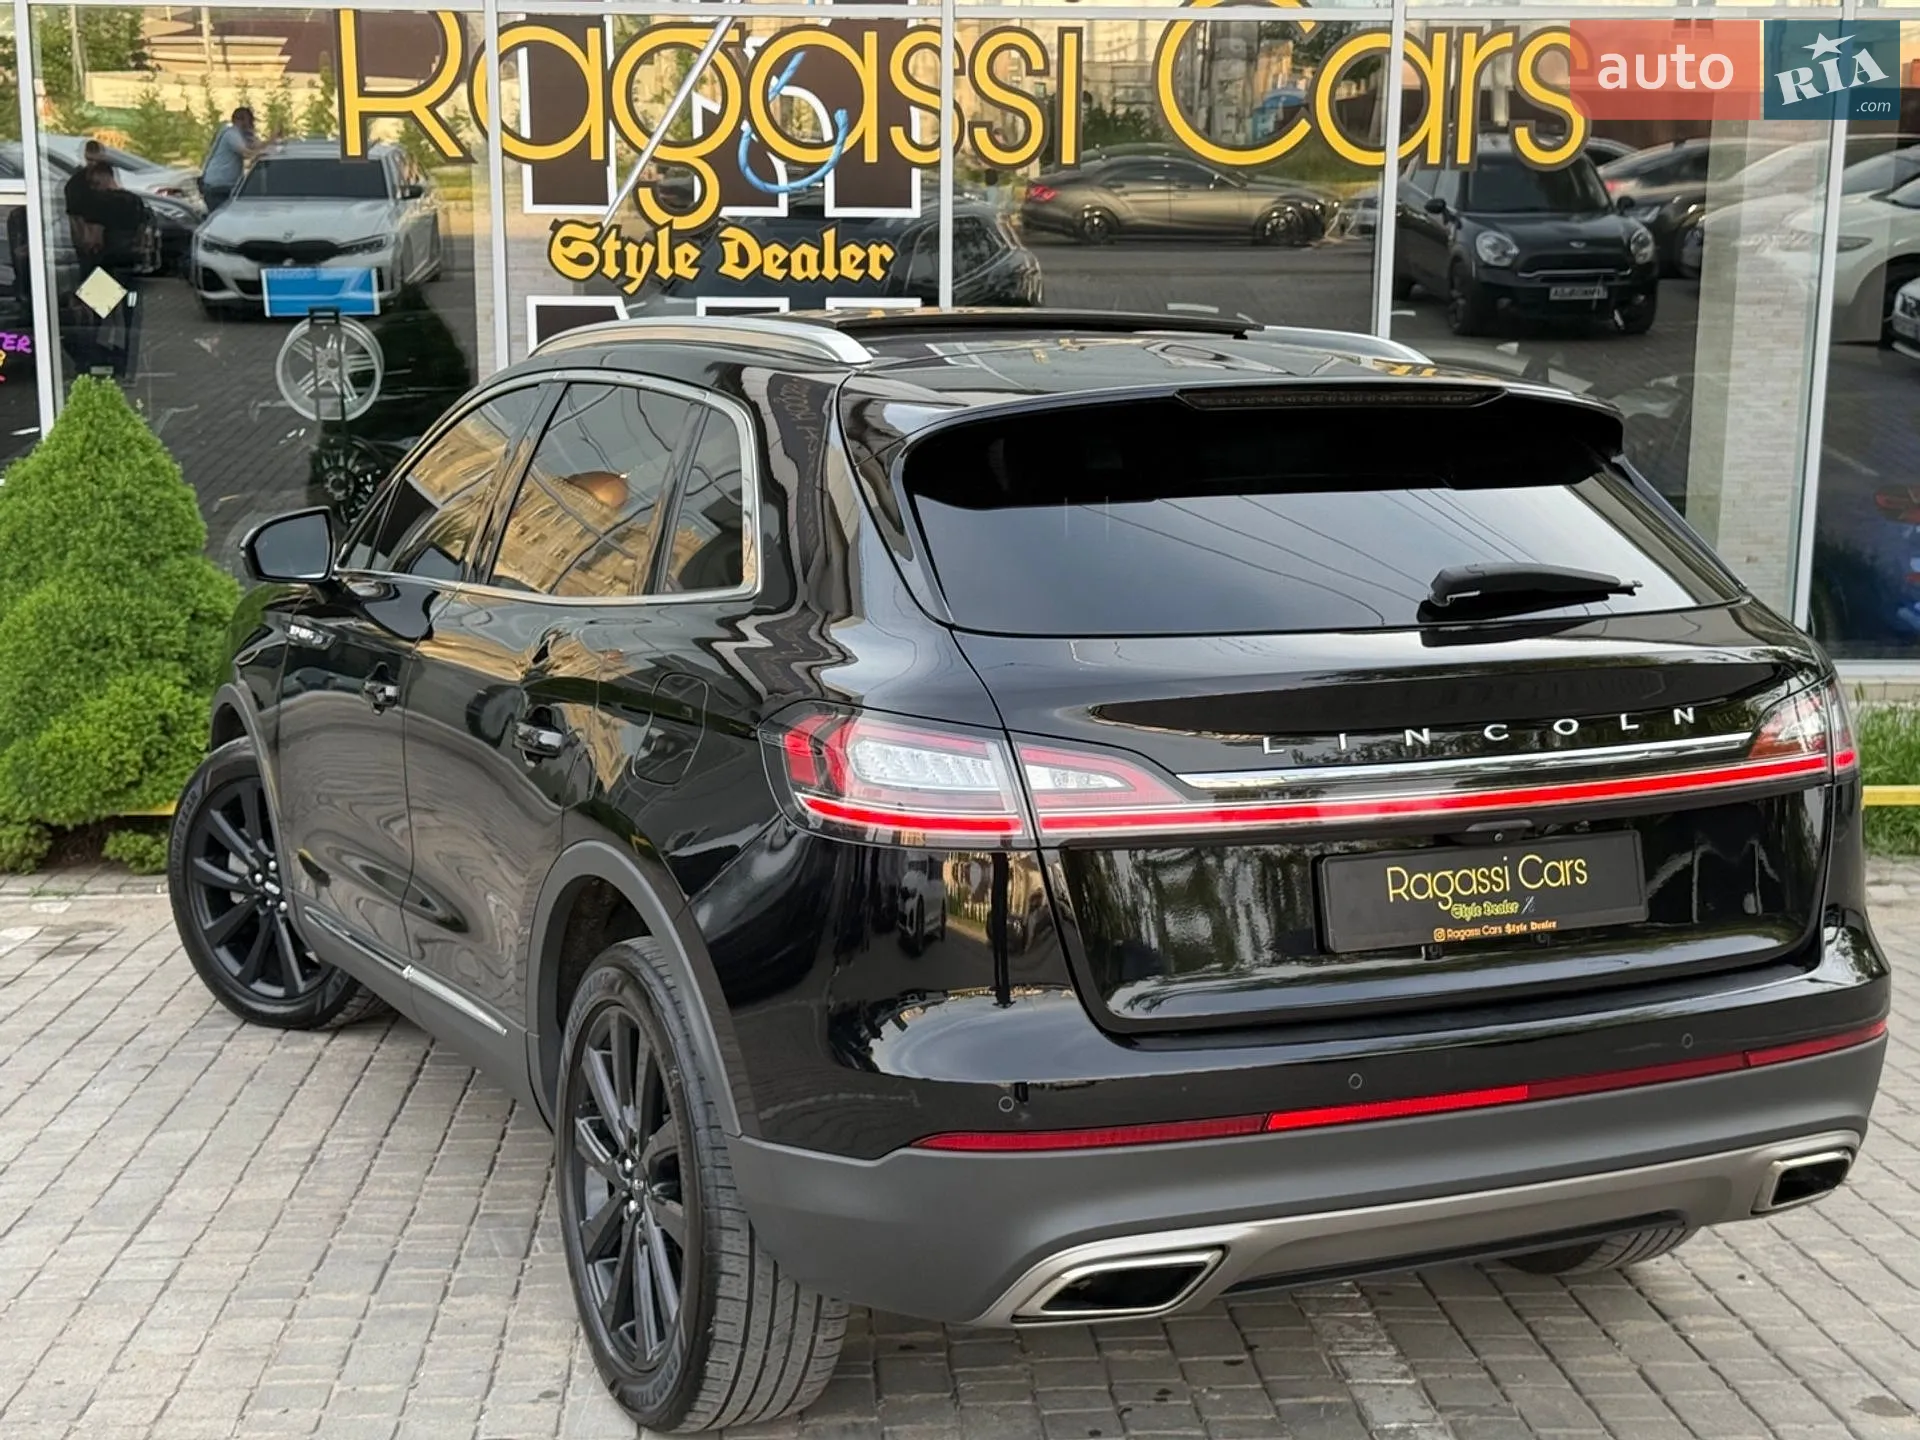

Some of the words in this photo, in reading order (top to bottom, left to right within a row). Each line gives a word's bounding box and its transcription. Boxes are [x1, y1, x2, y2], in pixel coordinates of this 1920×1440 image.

[338, 2, 1081, 231] Ragassi
[1152, 0, 1592, 169] Cars
[548, 219, 701, 295] Style
[717, 225, 895, 283] Dealer
[1262, 707, 1695, 754] LINCOLN
[1386, 856, 1511, 910] Ragassi
[1518, 854, 1588, 890] Cars
[1450, 903, 1482, 922] Style
[1482, 925, 1503, 936] Cars
